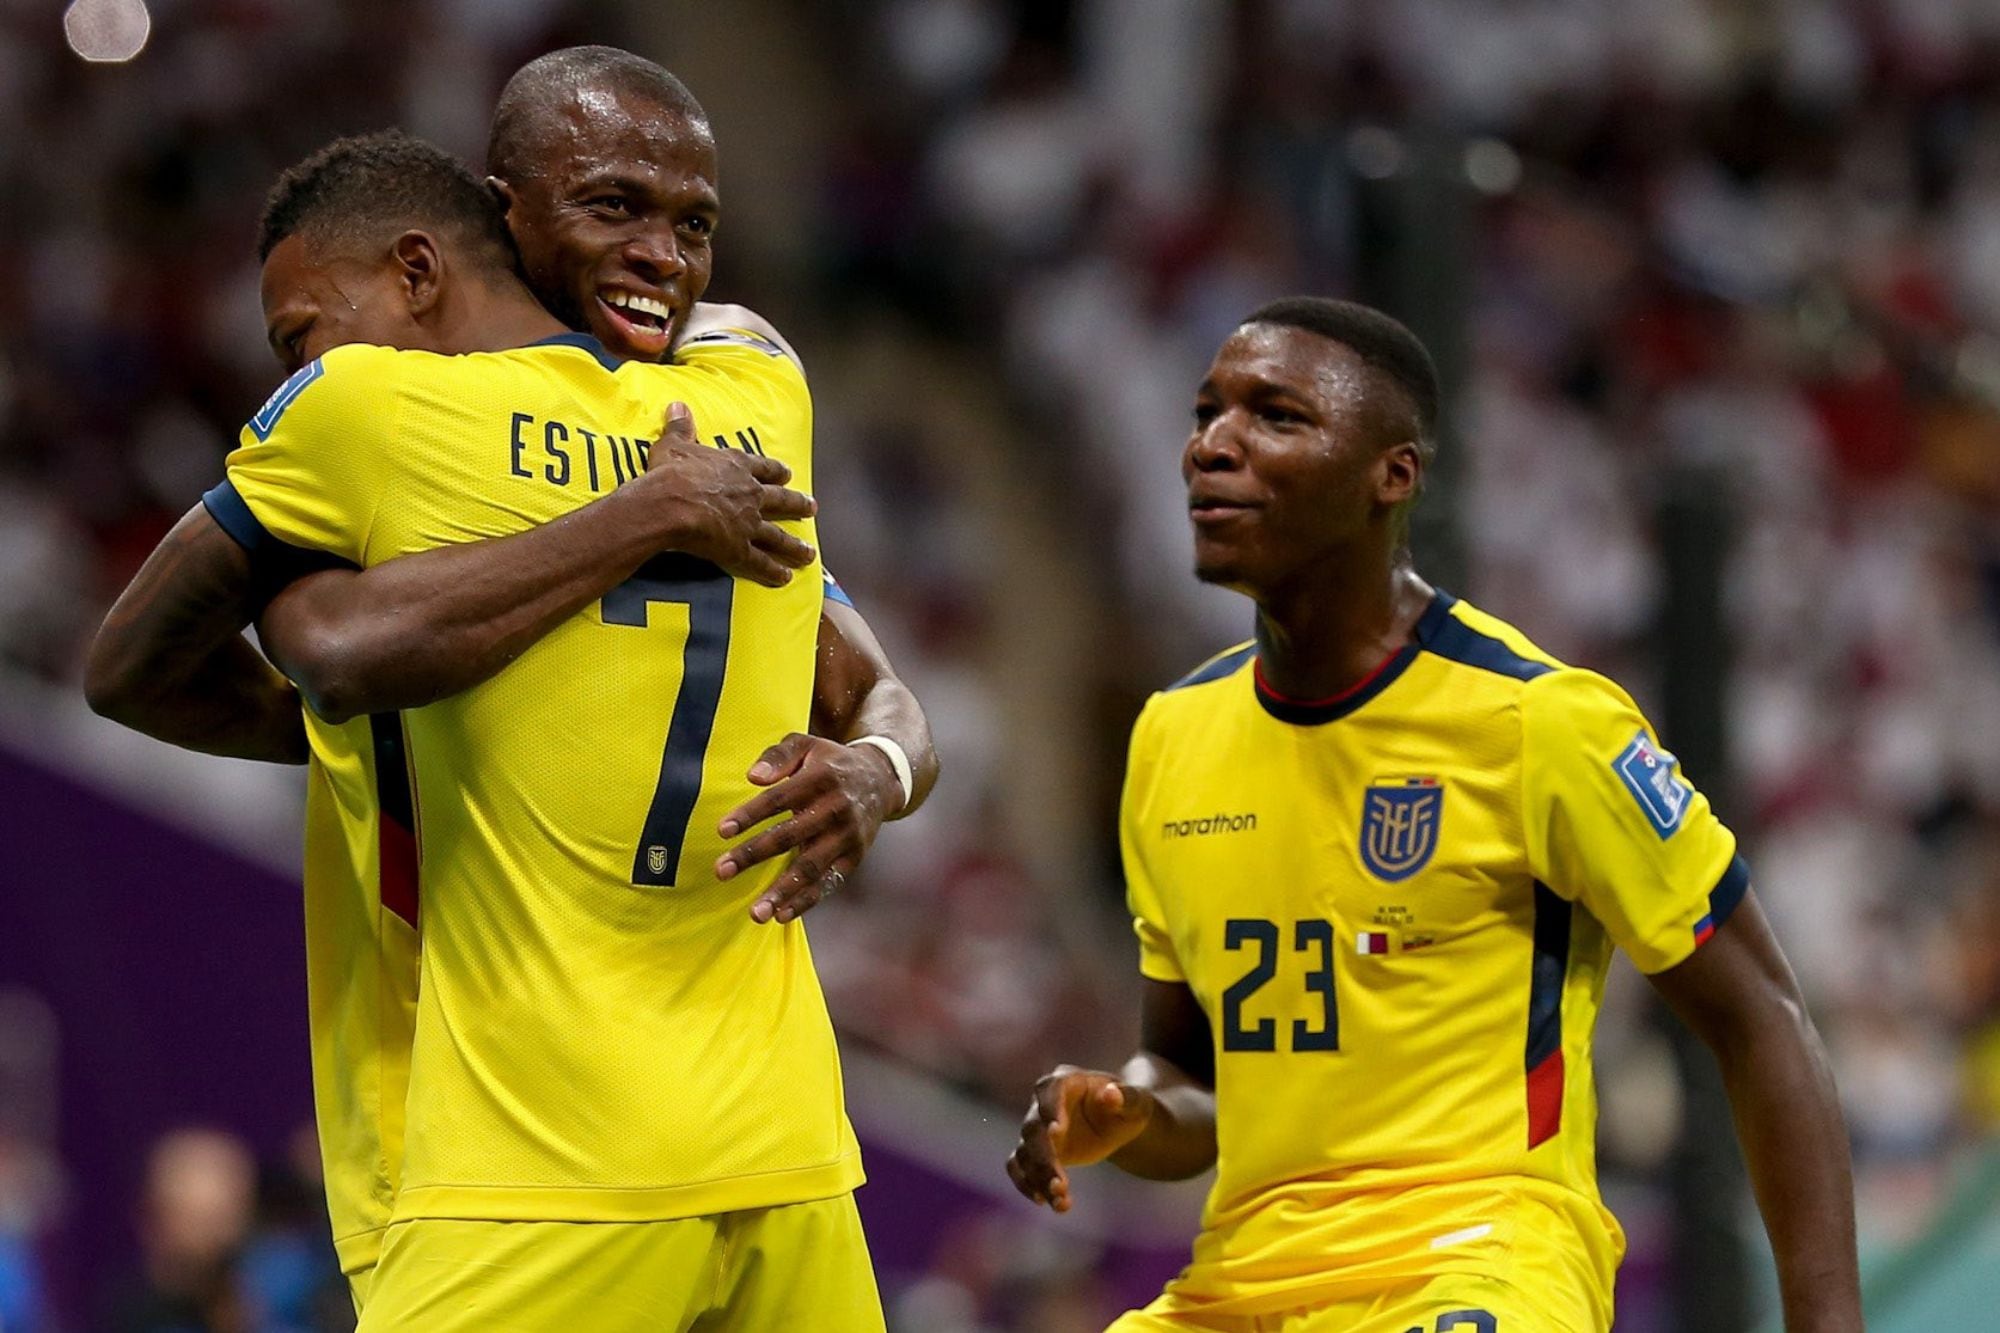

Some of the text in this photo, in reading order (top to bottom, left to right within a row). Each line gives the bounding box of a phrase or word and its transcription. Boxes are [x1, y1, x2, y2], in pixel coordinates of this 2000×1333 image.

[600, 550, 735, 887] 7
[1162, 813, 1257, 838] marathon
[1222, 919, 1339, 1052] 23
